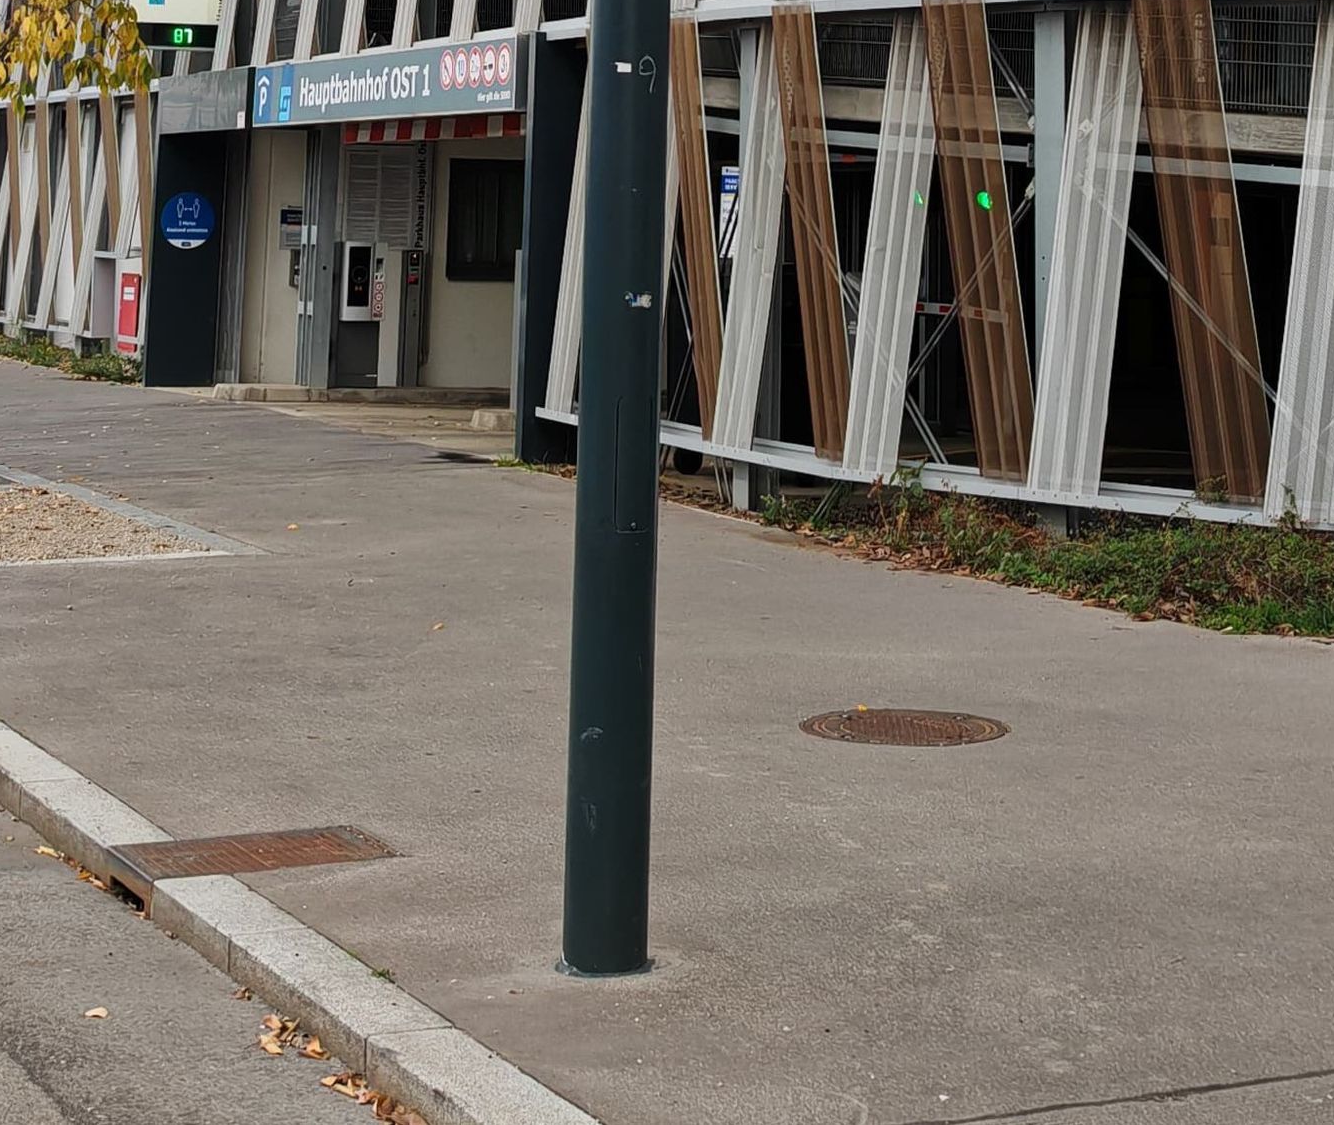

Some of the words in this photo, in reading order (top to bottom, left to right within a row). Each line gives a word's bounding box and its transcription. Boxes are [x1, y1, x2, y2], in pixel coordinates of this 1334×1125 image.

[173, 27, 193, 44] 87
[299, 67, 389, 114] Hauptbahnhof
[390, 65, 419, 100] OST
[422, 63, 430, 97] 1
